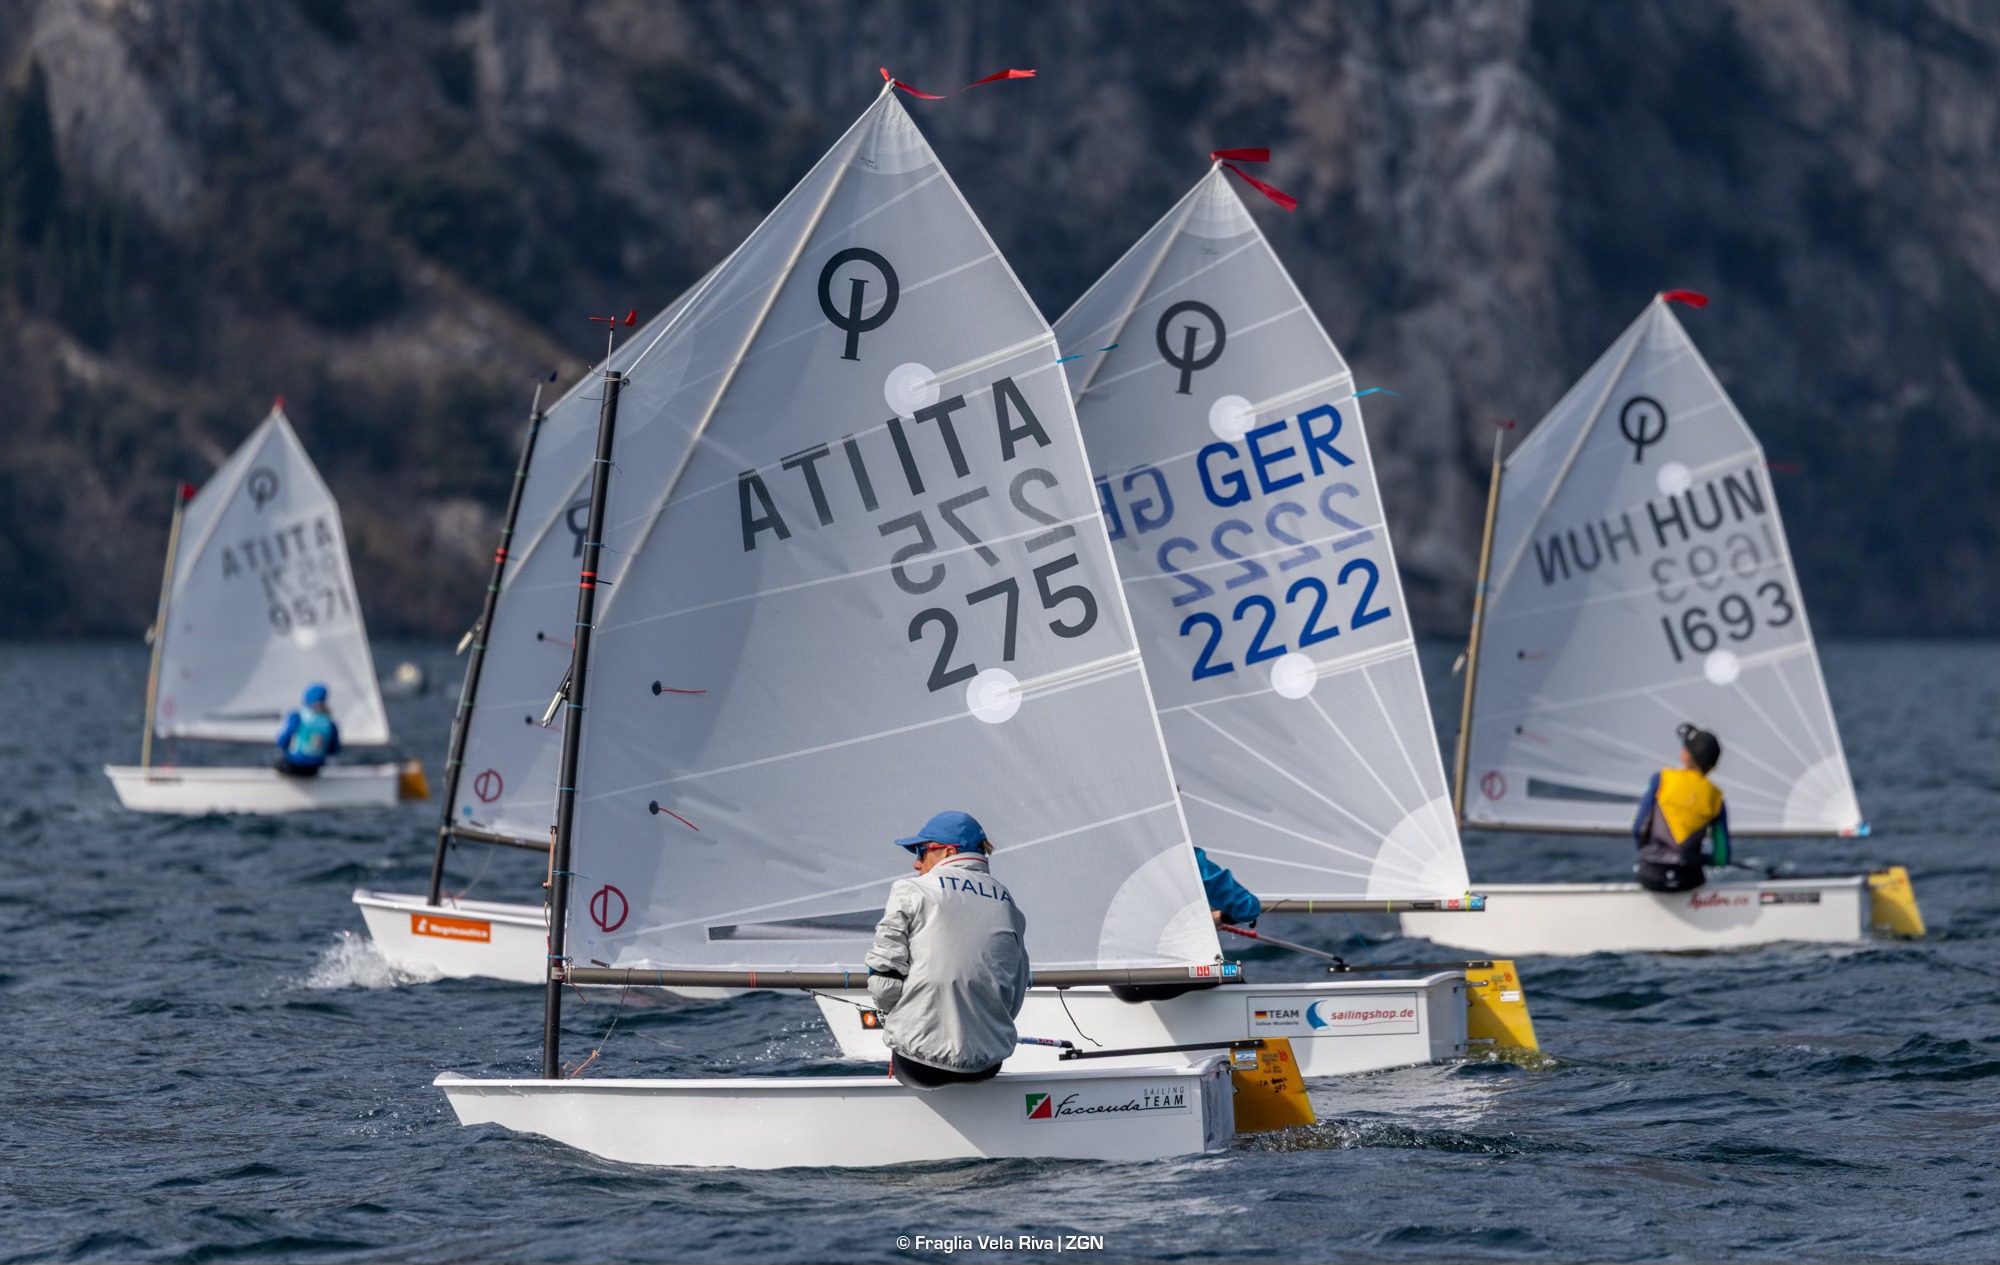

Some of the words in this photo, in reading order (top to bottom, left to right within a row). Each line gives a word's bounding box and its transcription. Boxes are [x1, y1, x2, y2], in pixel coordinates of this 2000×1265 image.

[886, 376, 1052, 496] ITA
[1196, 403, 1355, 508] GER
[1646, 468, 1766, 549] HUN
[908, 552, 1098, 693] 275
[1179, 558, 1391, 681] 2222
[1660, 580, 1795, 663] 1693
[939, 876, 1013, 902] ITALIA
[1268, 1010, 1299, 1019] TEAM
[1330, 1008, 1414, 1021] sailingshop.de
[1054, 1093, 1142, 1118] Faccenda
[1143, 1086, 1185, 1095] SAILING
[1144, 1094, 1184, 1107] TEAM
